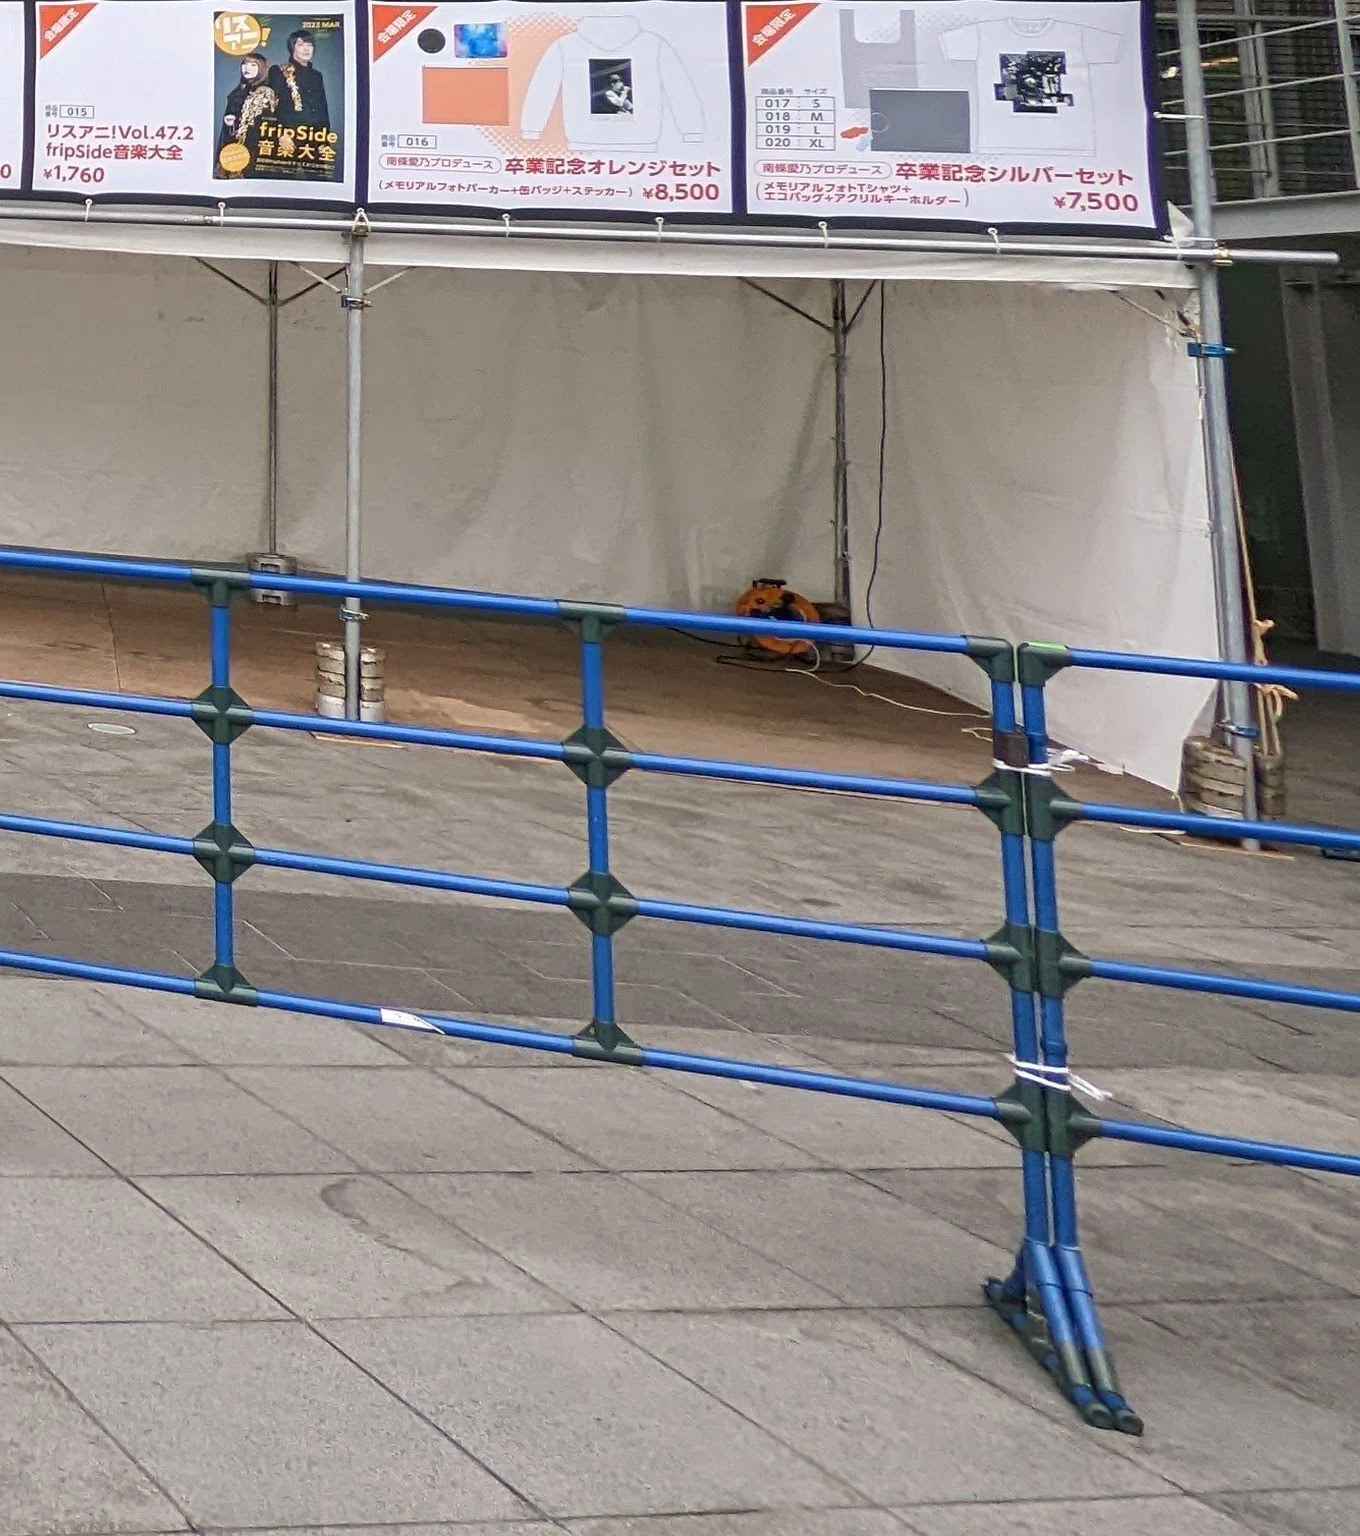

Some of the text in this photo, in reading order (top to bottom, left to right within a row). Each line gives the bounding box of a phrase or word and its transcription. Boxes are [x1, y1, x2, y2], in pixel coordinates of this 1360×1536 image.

[765, 99, 820, 108] 017 S
[67, 107, 87, 116] 015
[765, 112, 824, 122] 018 M
[765, 125, 821, 135] 019 L
[406, 137, 429, 146] 016
[765, 138, 825, 148] 020 XL
[46, 142, 184, 162] fripSide音楽大全
[43, 165, 105, 184] ¥1,760
[505, 157, 721, 178] 卒業記念オレンジセット
[895, 163, 1134, 186] 卒業記念シルバーセット
[643, 183, 720, 202] ¥8,500
[1053, 192, 1139, 212] ¥7,500
